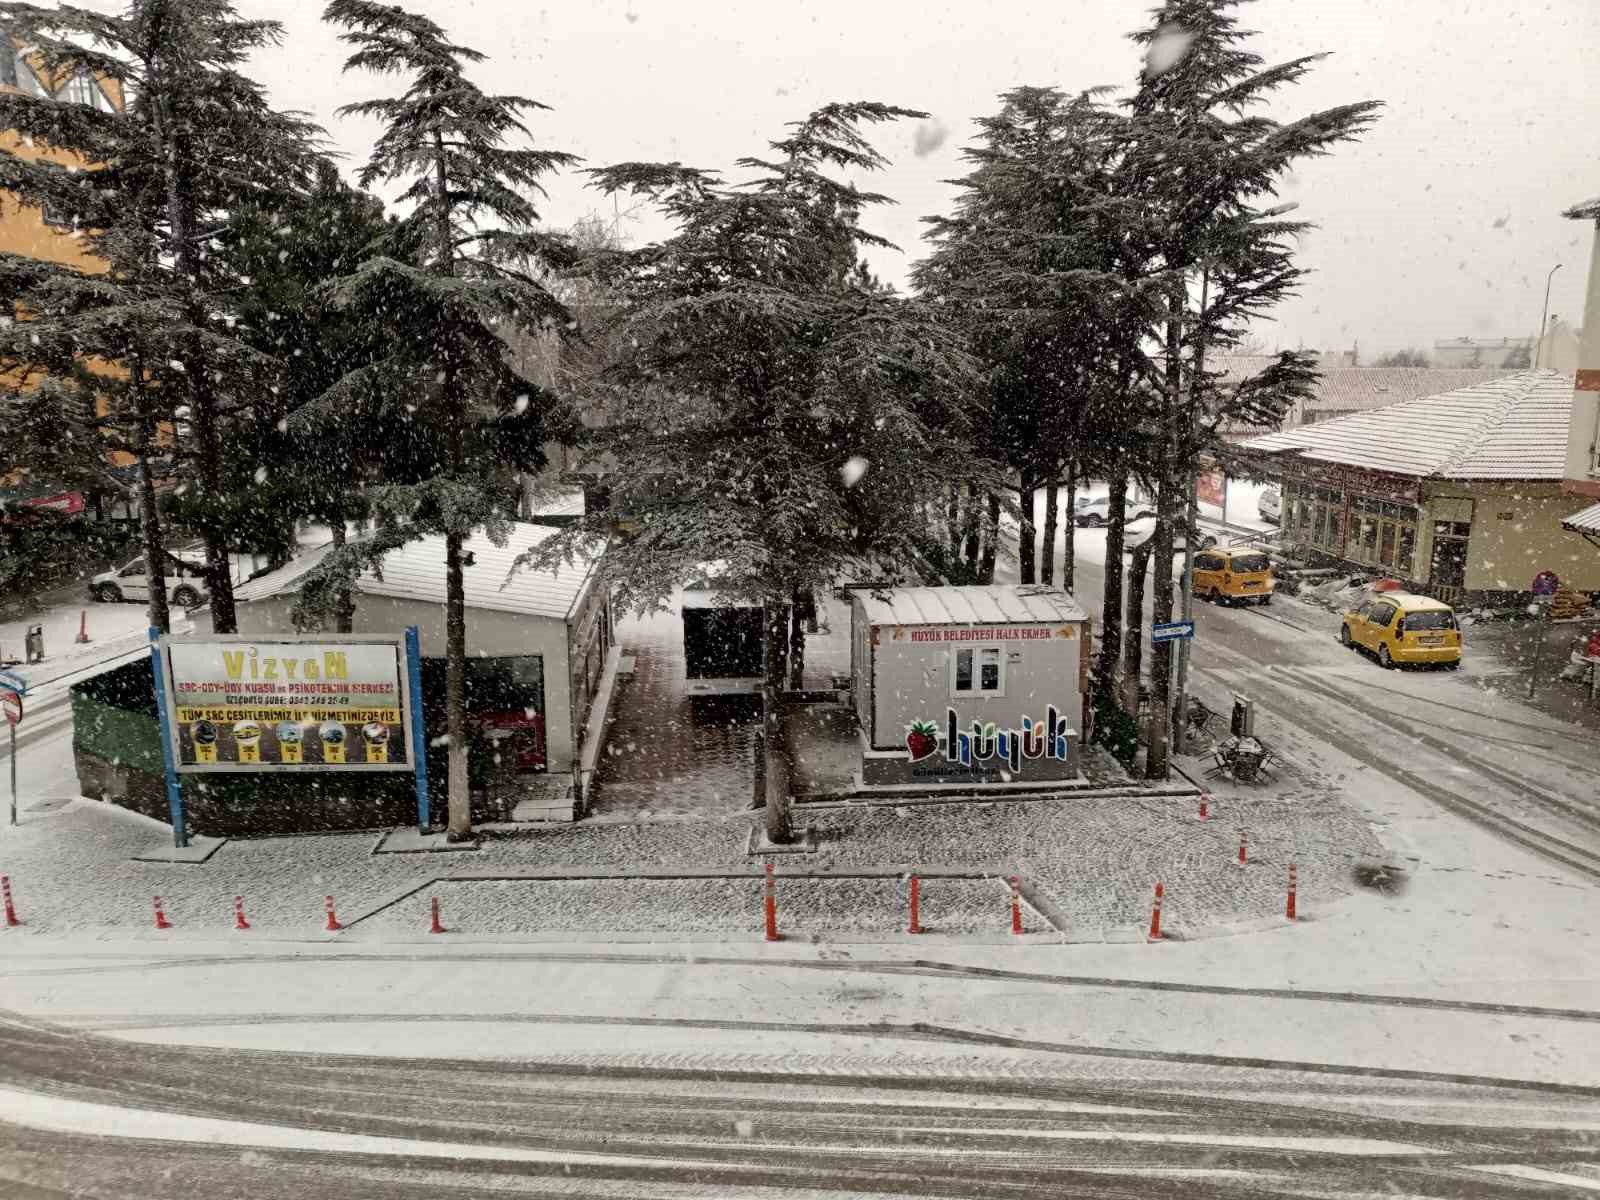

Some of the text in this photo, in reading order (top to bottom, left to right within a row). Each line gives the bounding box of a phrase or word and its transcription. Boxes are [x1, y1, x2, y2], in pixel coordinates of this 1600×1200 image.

[911, 627, 1051, 642] HÜYÜK BELEDİYESİ HALK EKMEK
[244, 682, 277, 693] KURSU
[352, 681, 394, 694] MERKEZİ
[182, 709, 203, 721] TÜM
[206, 710, 224, 721] SRC
[946, 704, 1068, 774] hüyük
